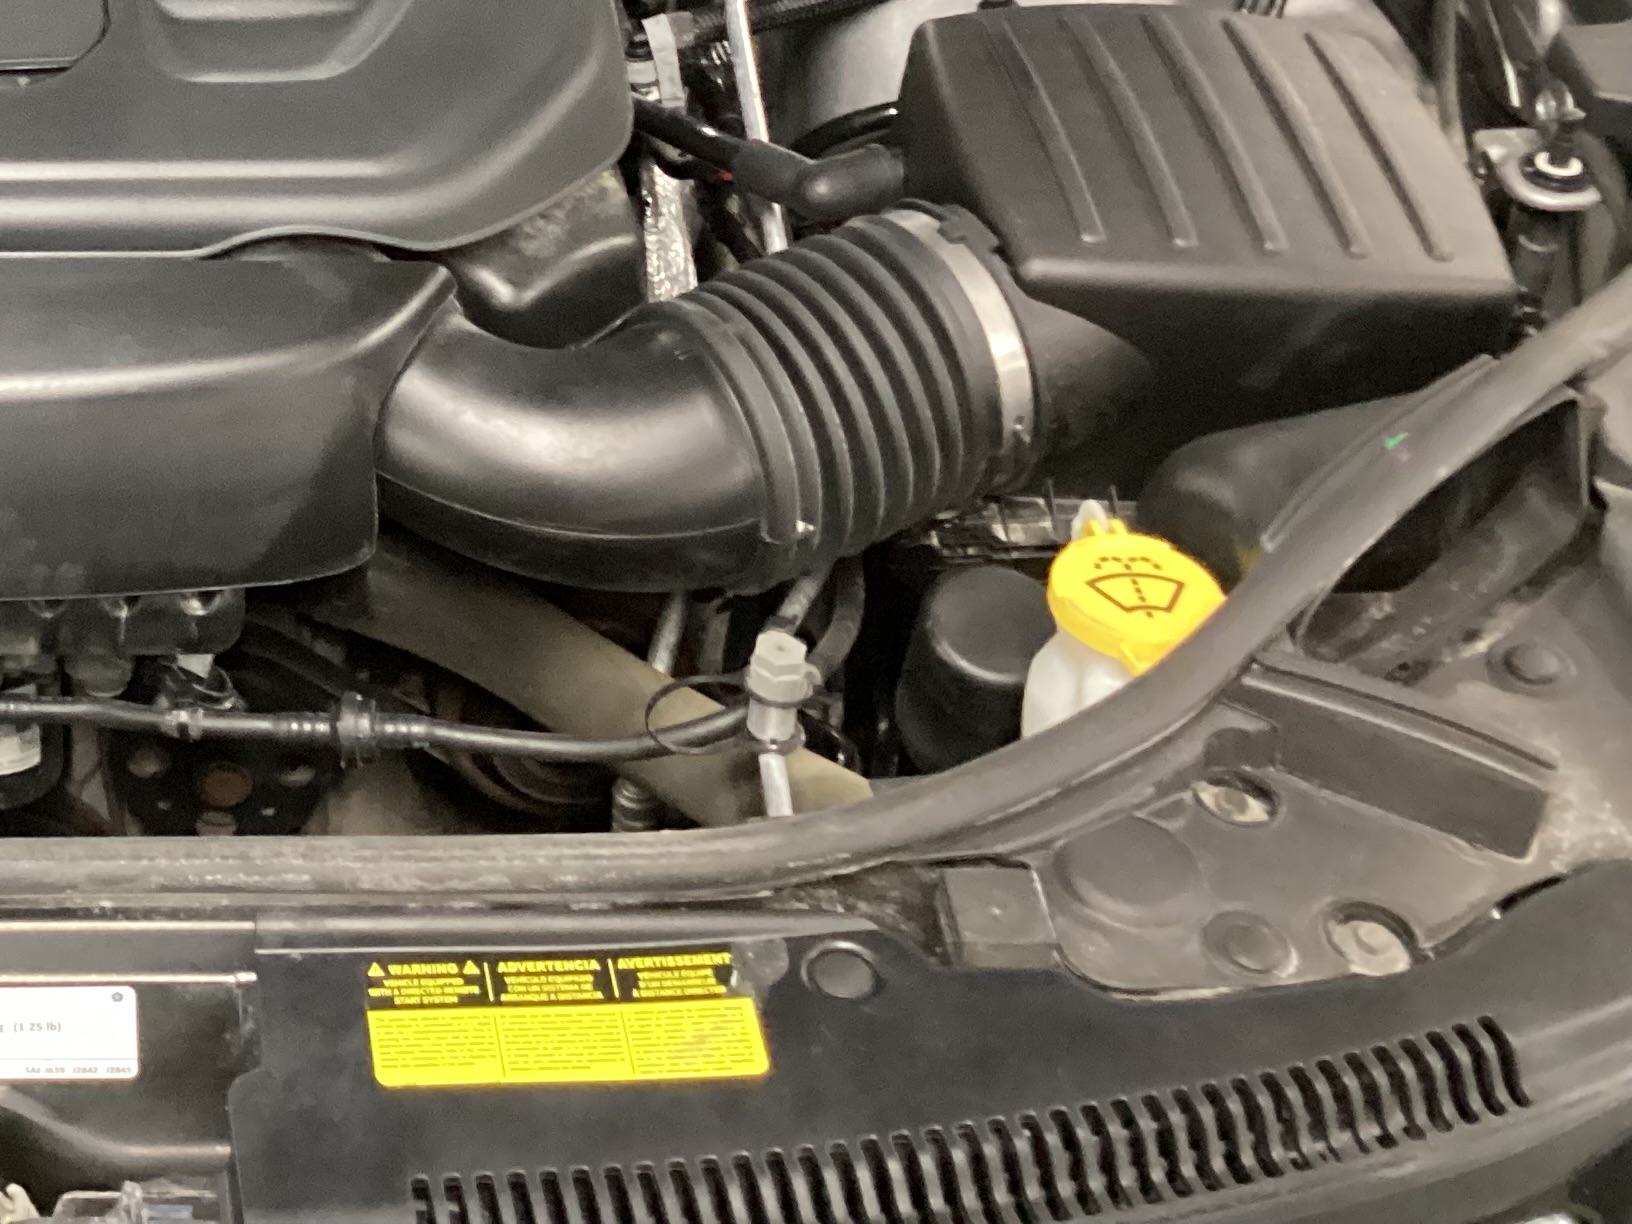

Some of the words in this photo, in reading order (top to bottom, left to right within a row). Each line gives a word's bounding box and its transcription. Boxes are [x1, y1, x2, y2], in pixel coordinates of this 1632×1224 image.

[497, 959, 602, 973] ADVERTENCIA
[617, 952, 732, 969] AVERTISSEMENT
[387, 963, 459, 976] WARNING
